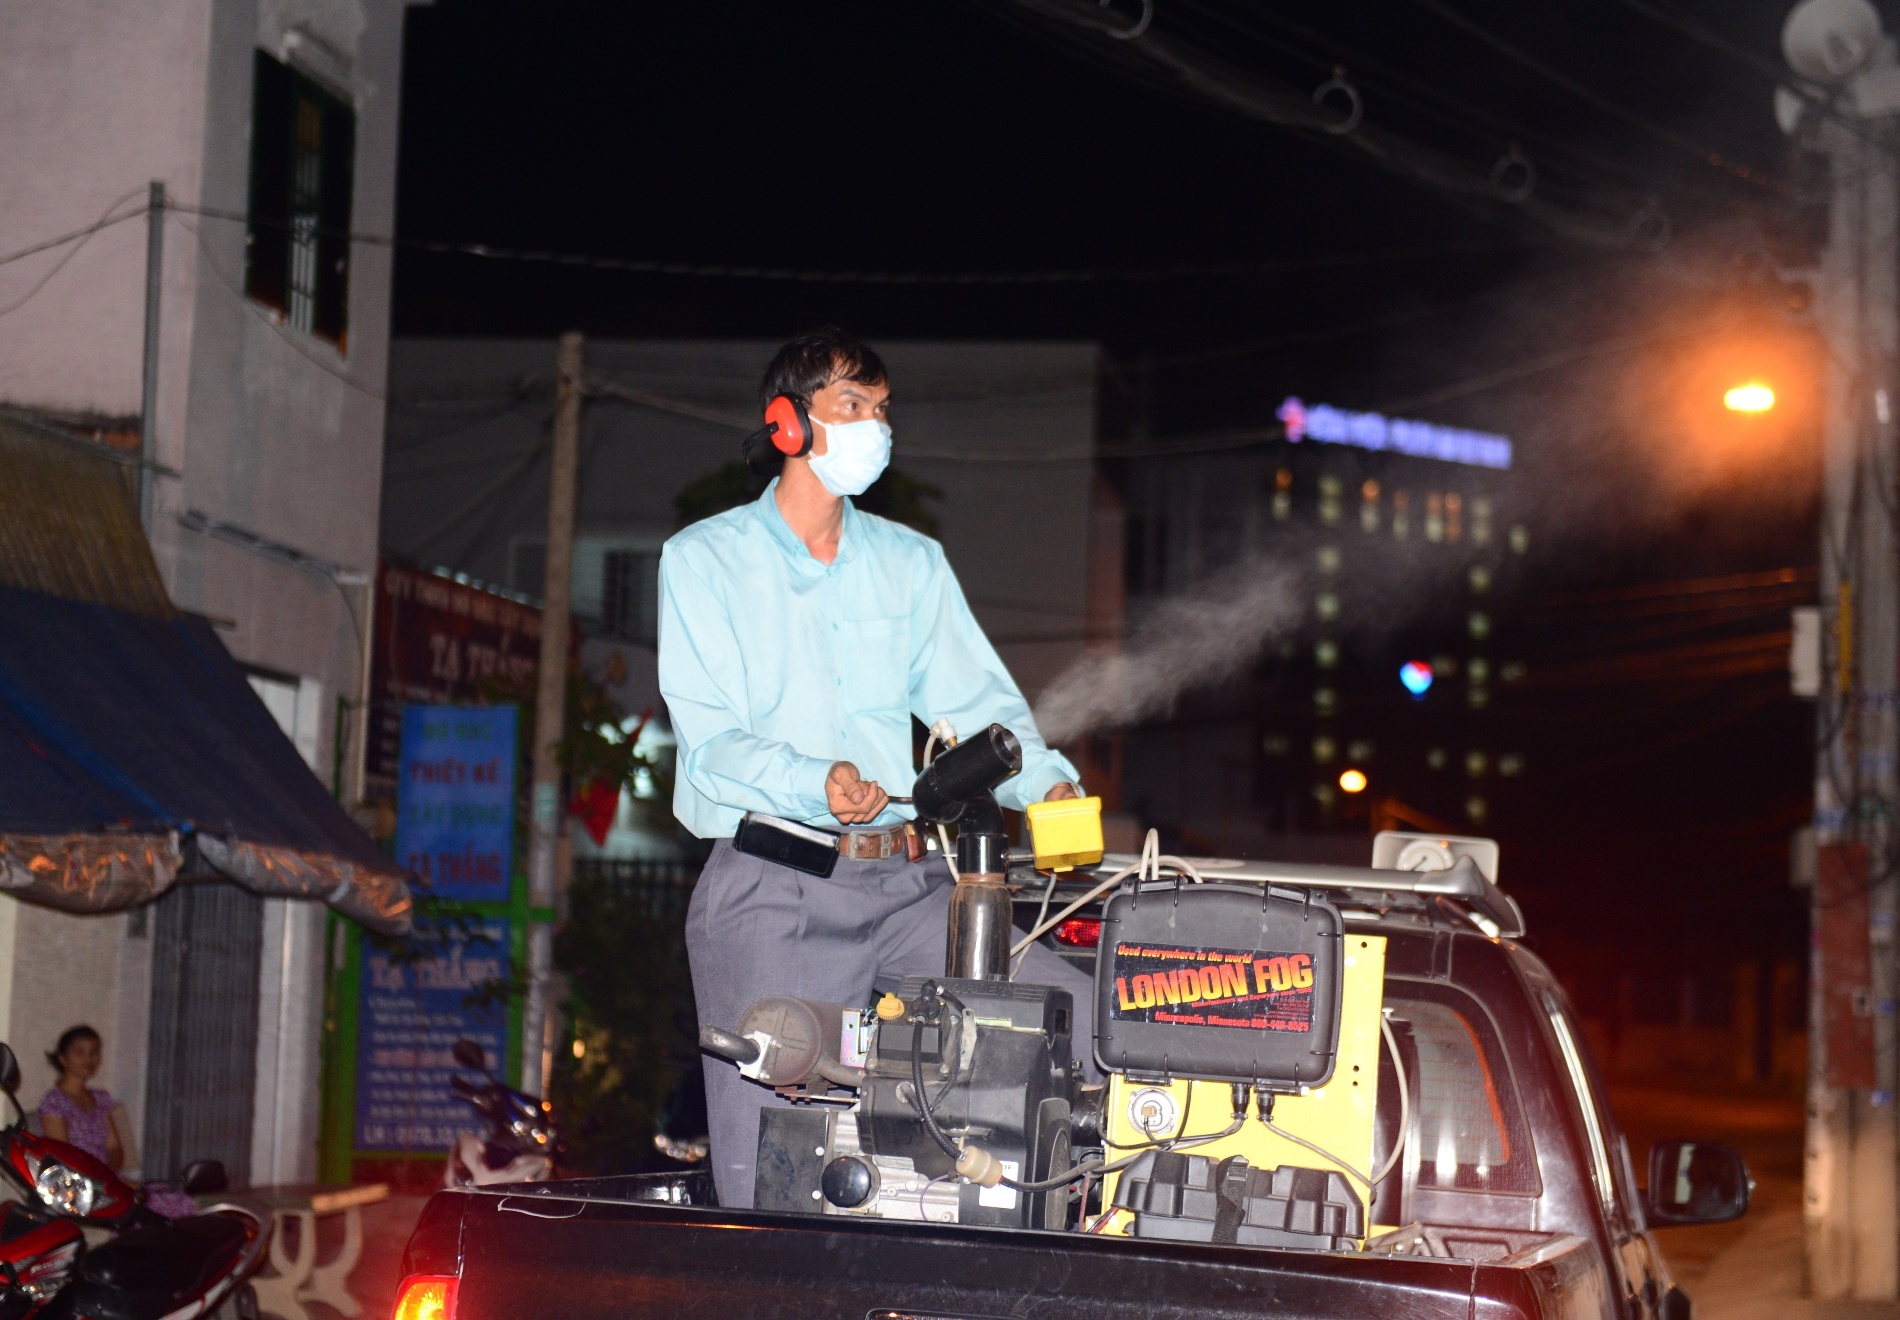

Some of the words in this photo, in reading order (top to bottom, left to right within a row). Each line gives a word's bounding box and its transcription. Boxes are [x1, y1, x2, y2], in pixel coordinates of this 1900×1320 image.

[1118, 946, 1141, 956] Used
[1142, 949, 1196, 960] everywhere
[1197, 951, 1207, 961] in
[1208, 951, 1224, 962] the
[1224, 953, 1253, 964] world
[1115, 962, 1249, 1012] LONDON
[1252, 954, 1314, 995] FOG
[1155, 1011, 1207, 1025] Minneapolis,
[1208, 1015, 1250, 1027] Minnesota
